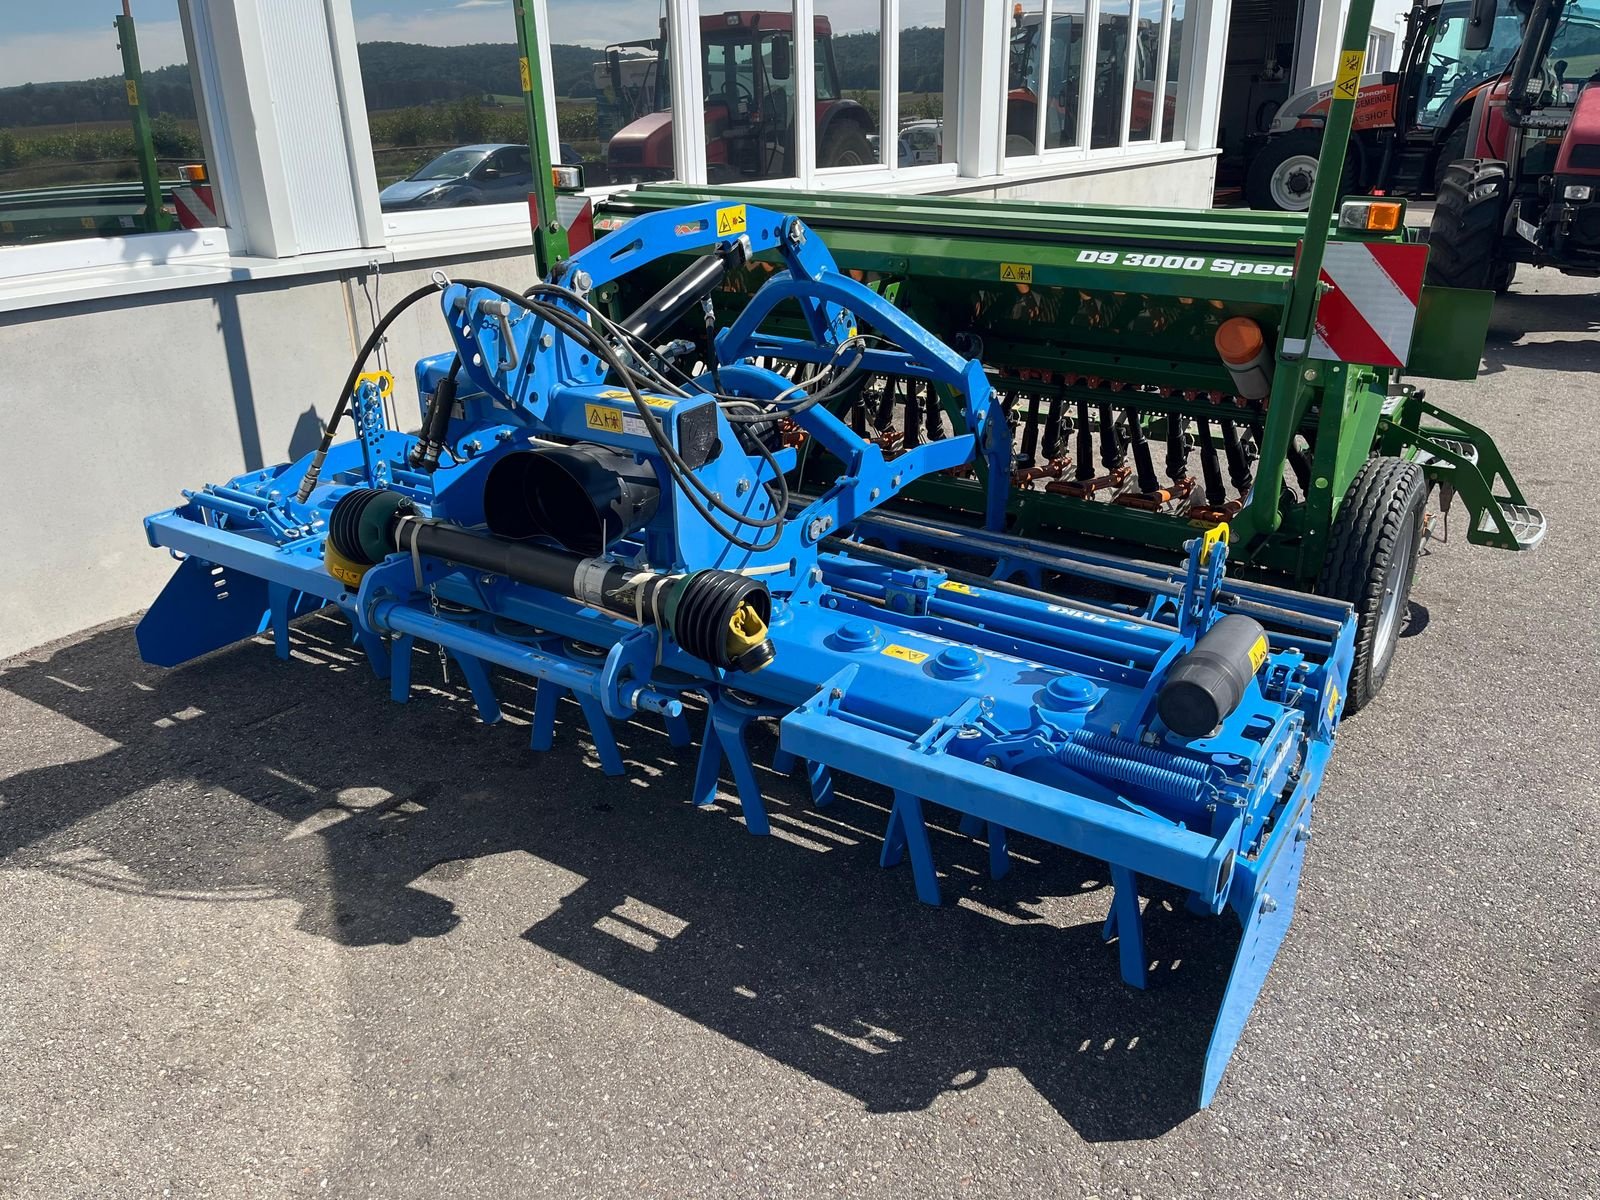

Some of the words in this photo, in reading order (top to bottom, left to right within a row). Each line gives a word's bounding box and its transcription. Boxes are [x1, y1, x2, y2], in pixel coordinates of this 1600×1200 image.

[1075, 250, 1119, 264] D9
[1122, 253, 1206, 271] 3000
[1209, 258, 1294, 276] Spec
